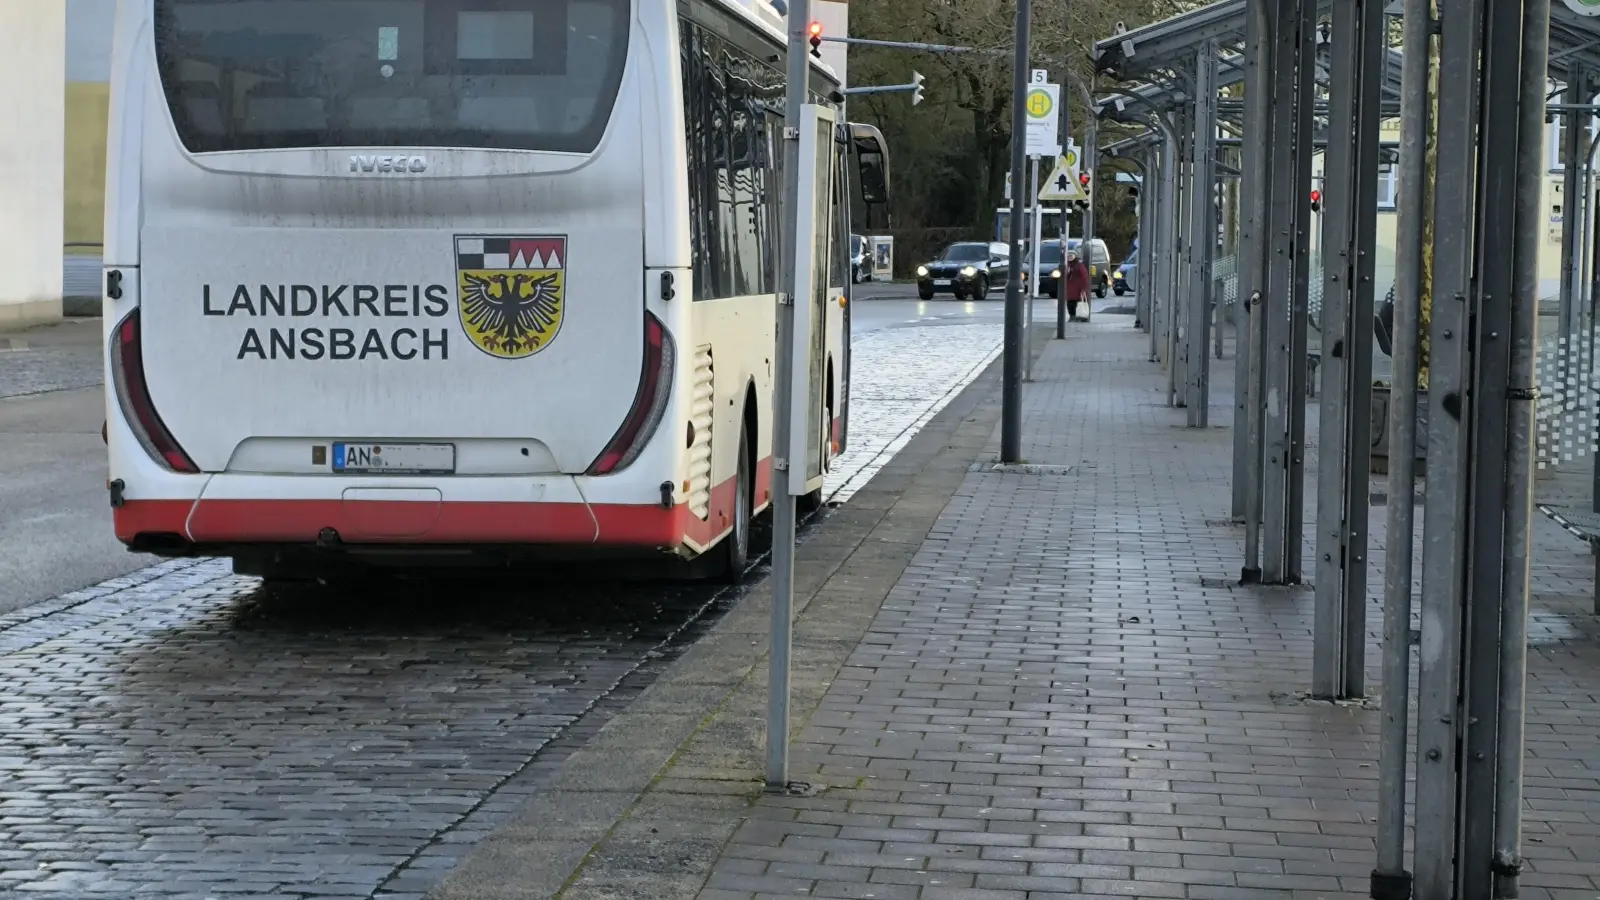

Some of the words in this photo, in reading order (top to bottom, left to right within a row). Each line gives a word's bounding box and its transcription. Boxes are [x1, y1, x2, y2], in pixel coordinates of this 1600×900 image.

[1035, 71, 1043, 82] 5
[1032, 95, 1044, 113] H
[349, 155, 427, 173] IVECO
[203, 284, 449, 317] LANDKREIS
[237, 328, 449, 360] ANSBACH
[346, 447, 371, 466] AN
